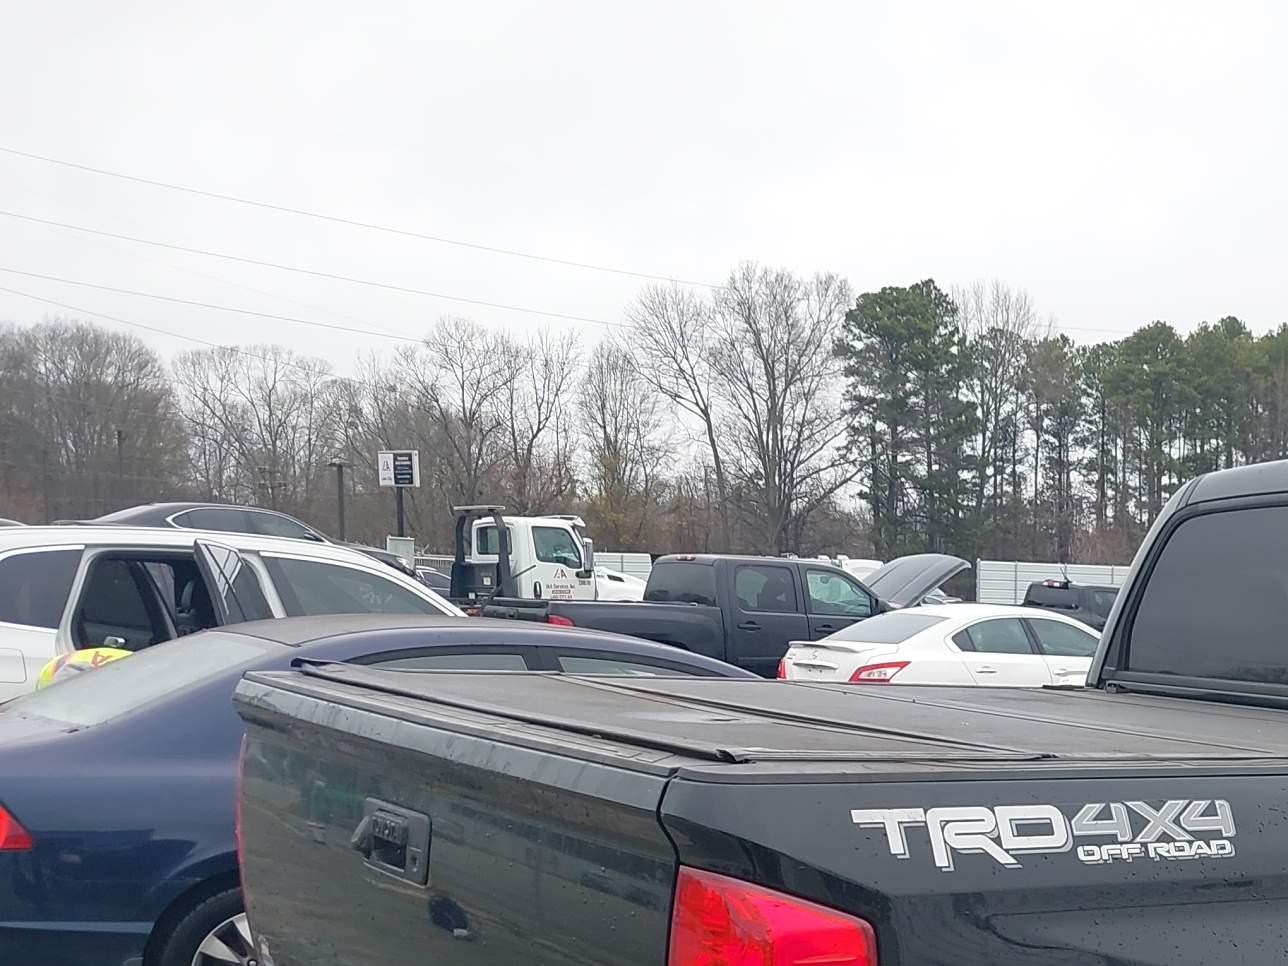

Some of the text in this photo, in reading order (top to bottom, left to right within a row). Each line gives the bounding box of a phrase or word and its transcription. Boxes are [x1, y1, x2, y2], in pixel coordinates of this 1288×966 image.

[850, 804, 1073, 872] TRD
[1077, 839, 1237, 864] OFF ROAD
